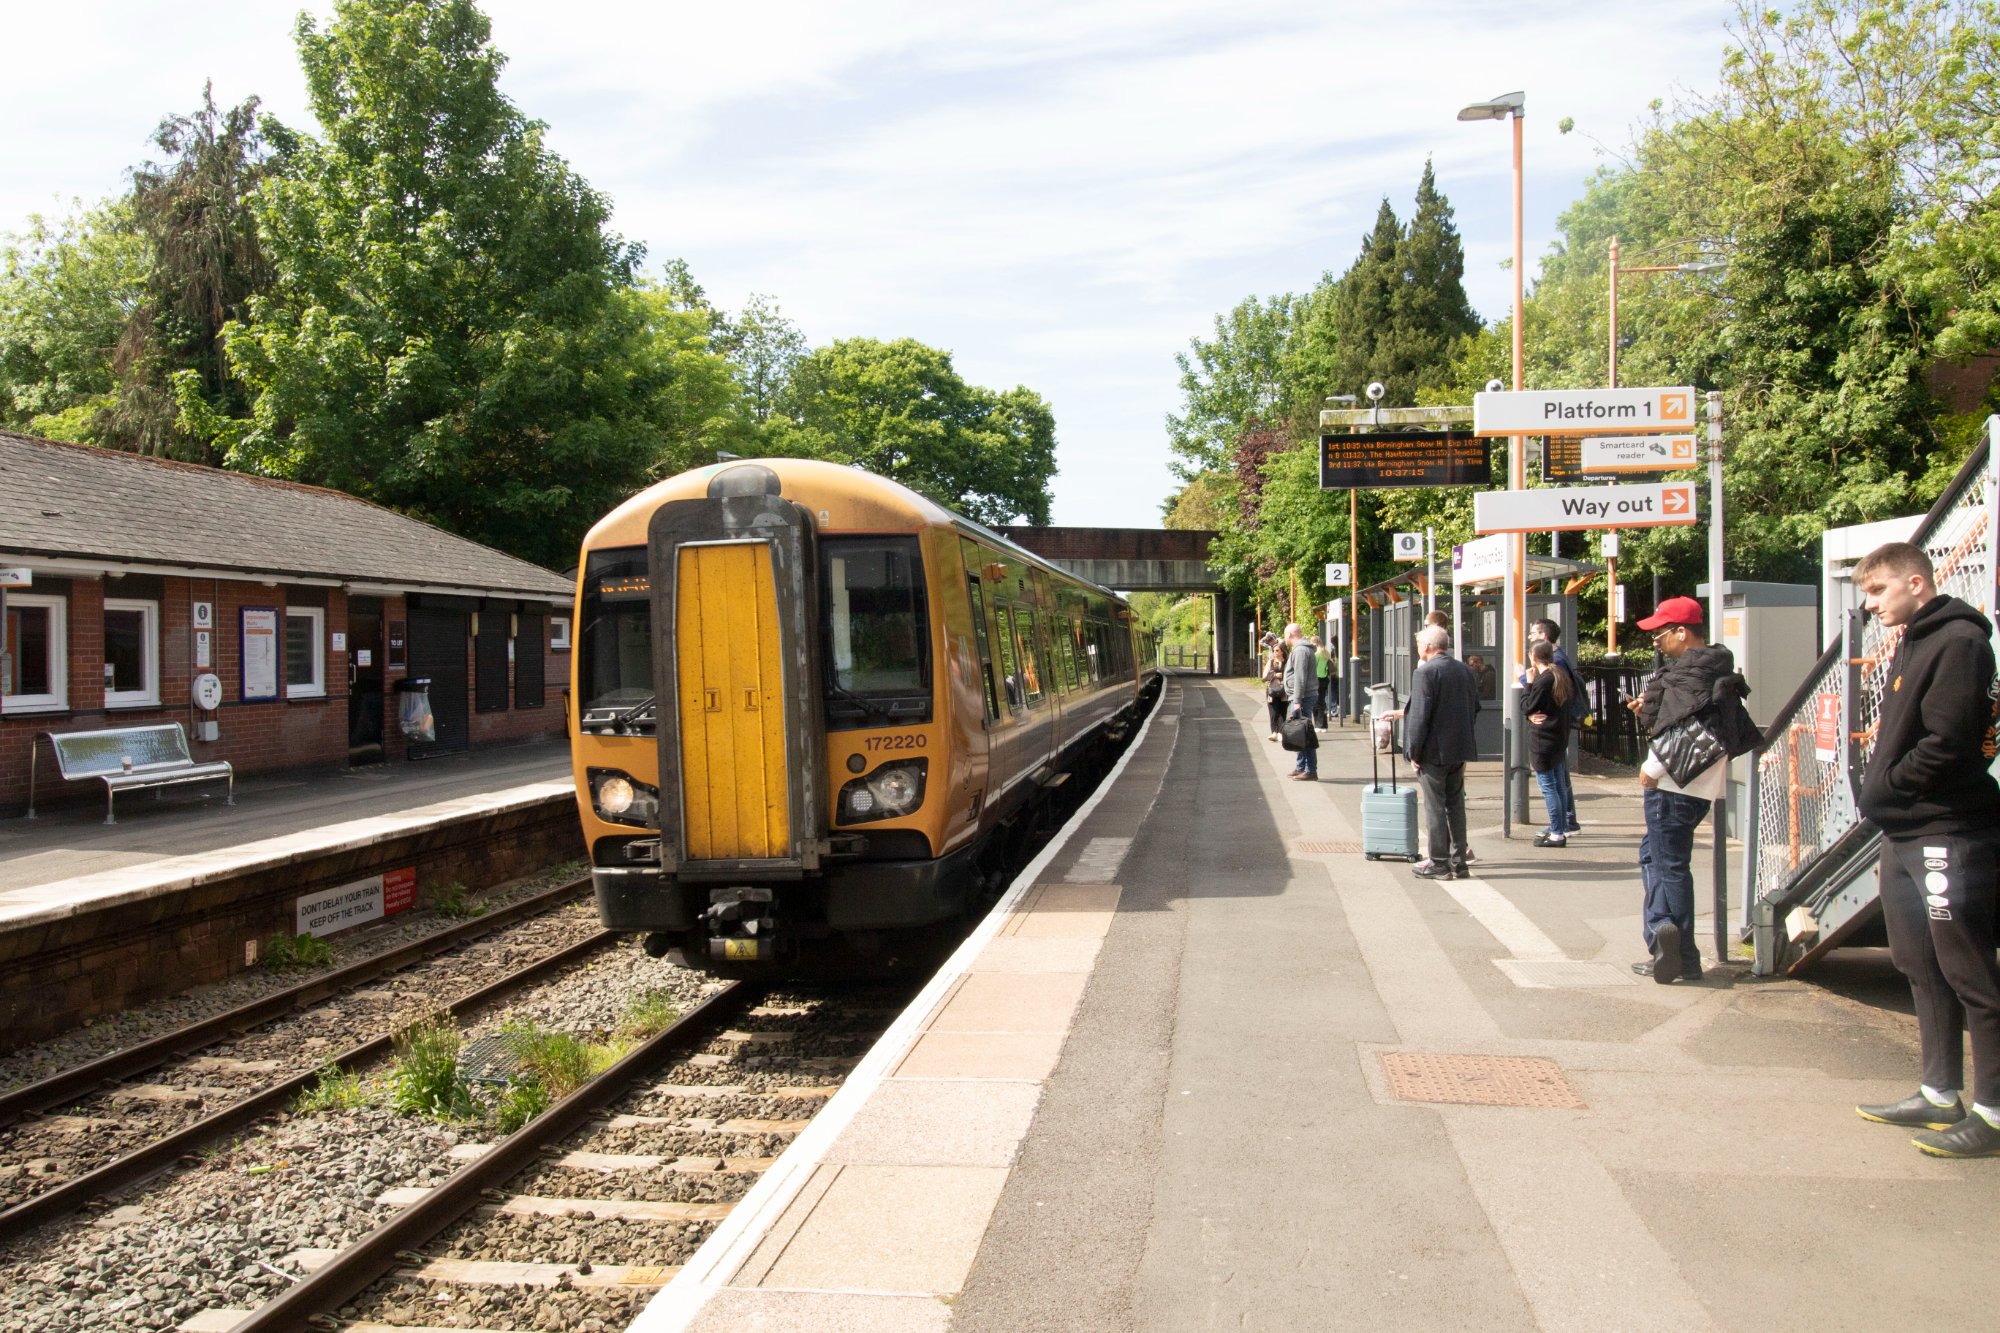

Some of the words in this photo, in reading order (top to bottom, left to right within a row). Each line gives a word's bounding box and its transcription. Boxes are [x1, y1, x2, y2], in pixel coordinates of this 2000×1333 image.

[1544, 401, 1636, 420] Platform
[1643, 401, 1651, 417] 1
[1599, 441, 1645, 450] Smartcard
[1617, 452, 1645, 460] reader
[1379, 468, 1425, 477] 10:37:15
[1562, 498, 1611, 518] Way
[1617, 496, 1653, 513] out
[1333, 569, 1342, 580] 2
[864, 734, 927, 751] 172220
[301, 902, 322, 916] DON'T
[322, 896, 344, 910] DELAY
[344, 890, 362, 904] YOUR
[362, 885, 380, 900] TRAIN
[309, 915, 327, 929] KEEP
[327, 911, 340, 923] OFF
[341, 907, 353, 919] THE
[354, 901, 374, 915] TRACK
